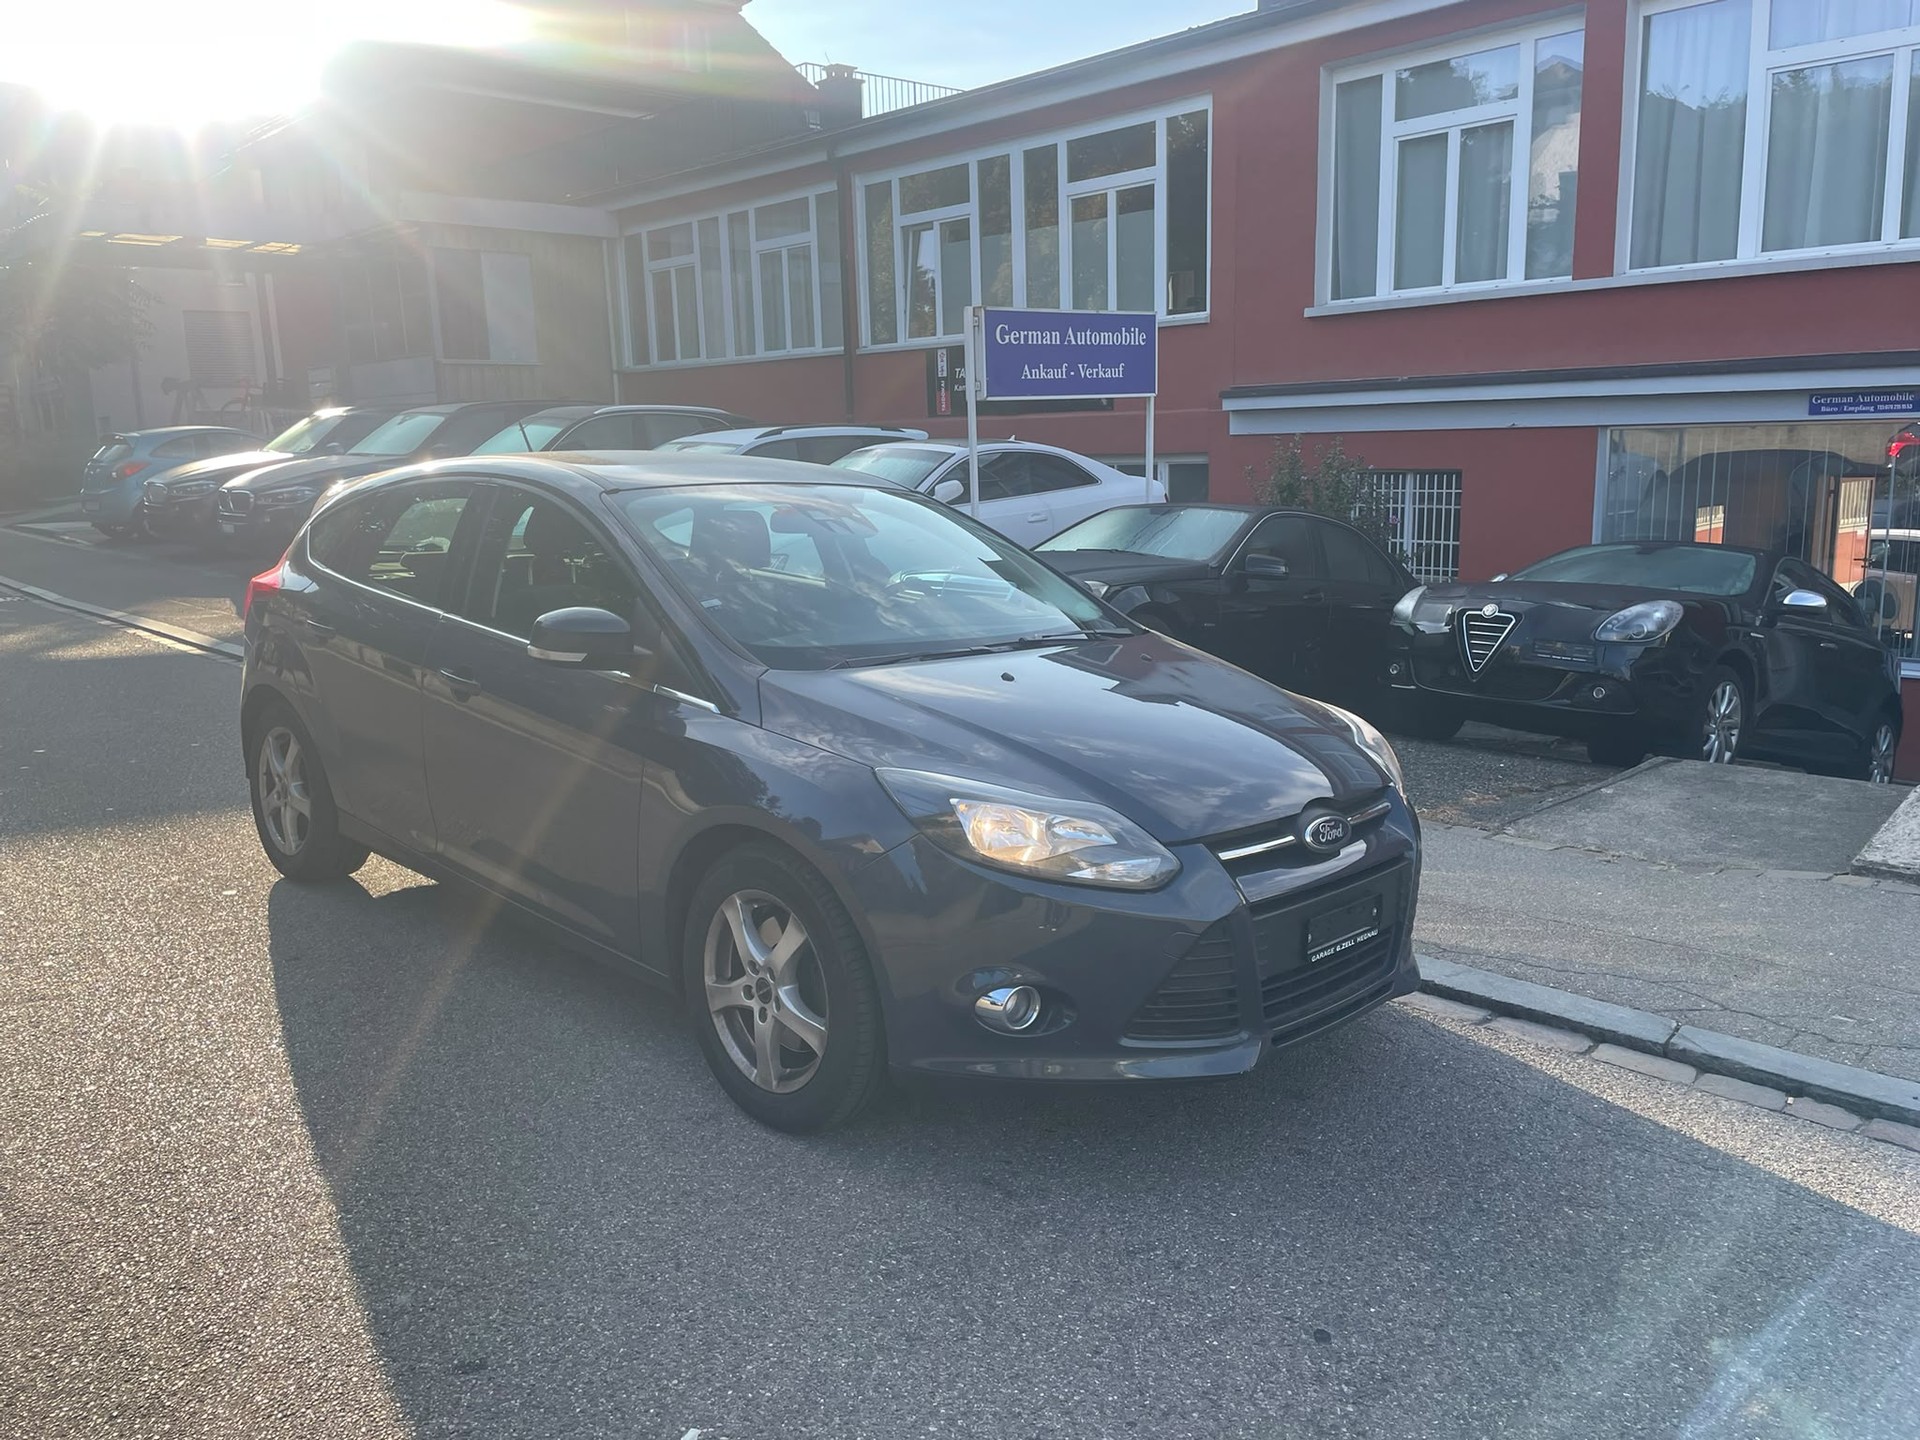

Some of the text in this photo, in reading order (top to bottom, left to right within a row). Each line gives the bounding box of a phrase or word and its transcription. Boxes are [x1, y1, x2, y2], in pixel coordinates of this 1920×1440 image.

[995, 323, 1147, 346] German Automobile
[1021, 363, 1068, 380] Ankauf
[1078, 362, 1125, 379] Verkauf
[1812, 392, 1915, 405] German Automobile
[1319, 821, 1344, 843] Ford
[1311, 947, 1335, 963] GARAGE
